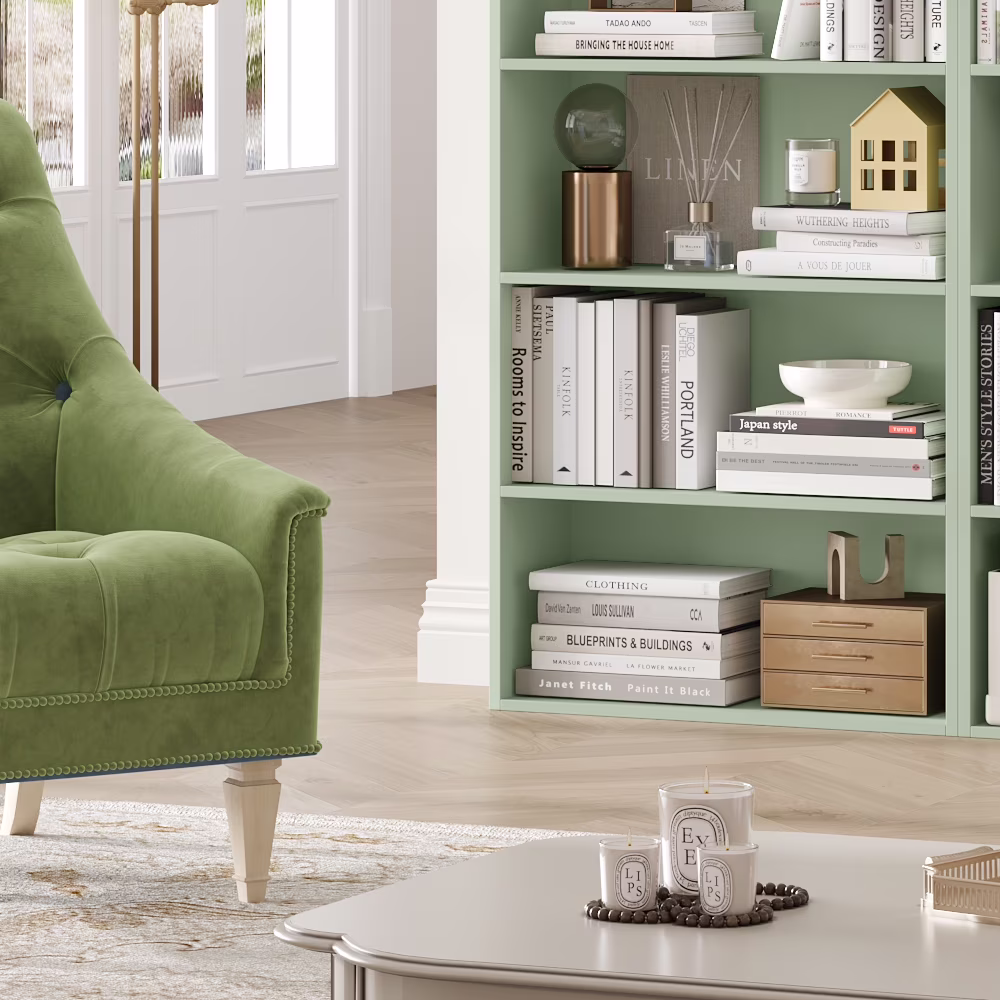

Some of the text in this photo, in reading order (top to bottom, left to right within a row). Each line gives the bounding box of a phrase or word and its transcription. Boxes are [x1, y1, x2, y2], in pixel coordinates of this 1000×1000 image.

[606, 19, 651, 27] TADAO ANDO
[575, 40, 674, 50] BRINGING THE HOUSE HOME
[645, 157, 742, 182] LINEN
[796, 215, 890, 229] WUTHERING HEIGHTS
[532, 304, 542, 361] SIETSEMA
[660, 344, 670, 374] LESLIE
[561, 366, 571, 417] KINFOLK
[624, 370, 634, 421] KINFOLK
[511, 348, 528, 472] Rooms to Inspire
[980, 324, 993, 485] MEN'S STYLE STORIES
[680, 381, 694, 459] PORTLAND
[739, 418, 798, 432] Japan style
[585, 580, 648, 591] CLOTHING
[591, 603, 635, 619] LOUIS SULLIVAN
[566, 634, 693, 652] BLUEPRINTS & BUILDINGS
[538, 678, 711, 697] Janet Fitch Paint It Black
